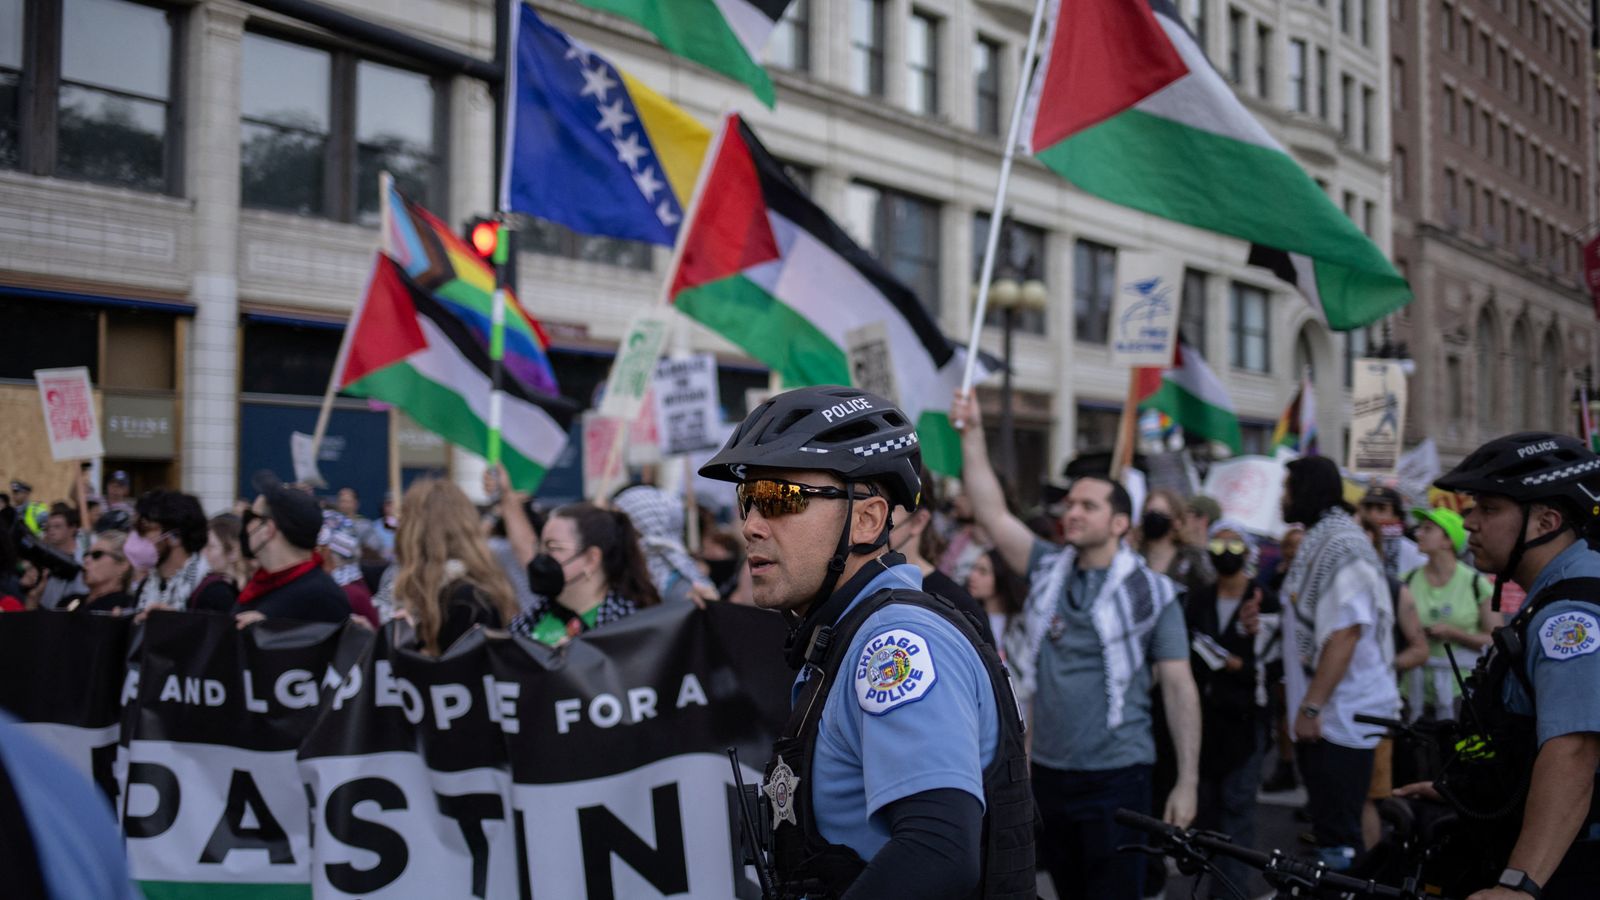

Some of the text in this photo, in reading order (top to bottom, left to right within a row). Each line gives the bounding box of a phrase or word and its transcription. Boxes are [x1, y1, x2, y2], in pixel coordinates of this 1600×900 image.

[821, 397, 873, 423] POLICE
[1517, 440, 1559, 458] POLICE
[1545, 614, 1593, 638] CHICAGO
[857, 635, 920, 680] CHICAGO
[1552, 636, 1596, 655] POLICE
[160, 674, 226, 707] AND
[243, 663, 343, 714] LG
[554, 686, 658, 734] FOR
[675, 672, 709, 709] A
[865, 668, 924, 704] POLICE
